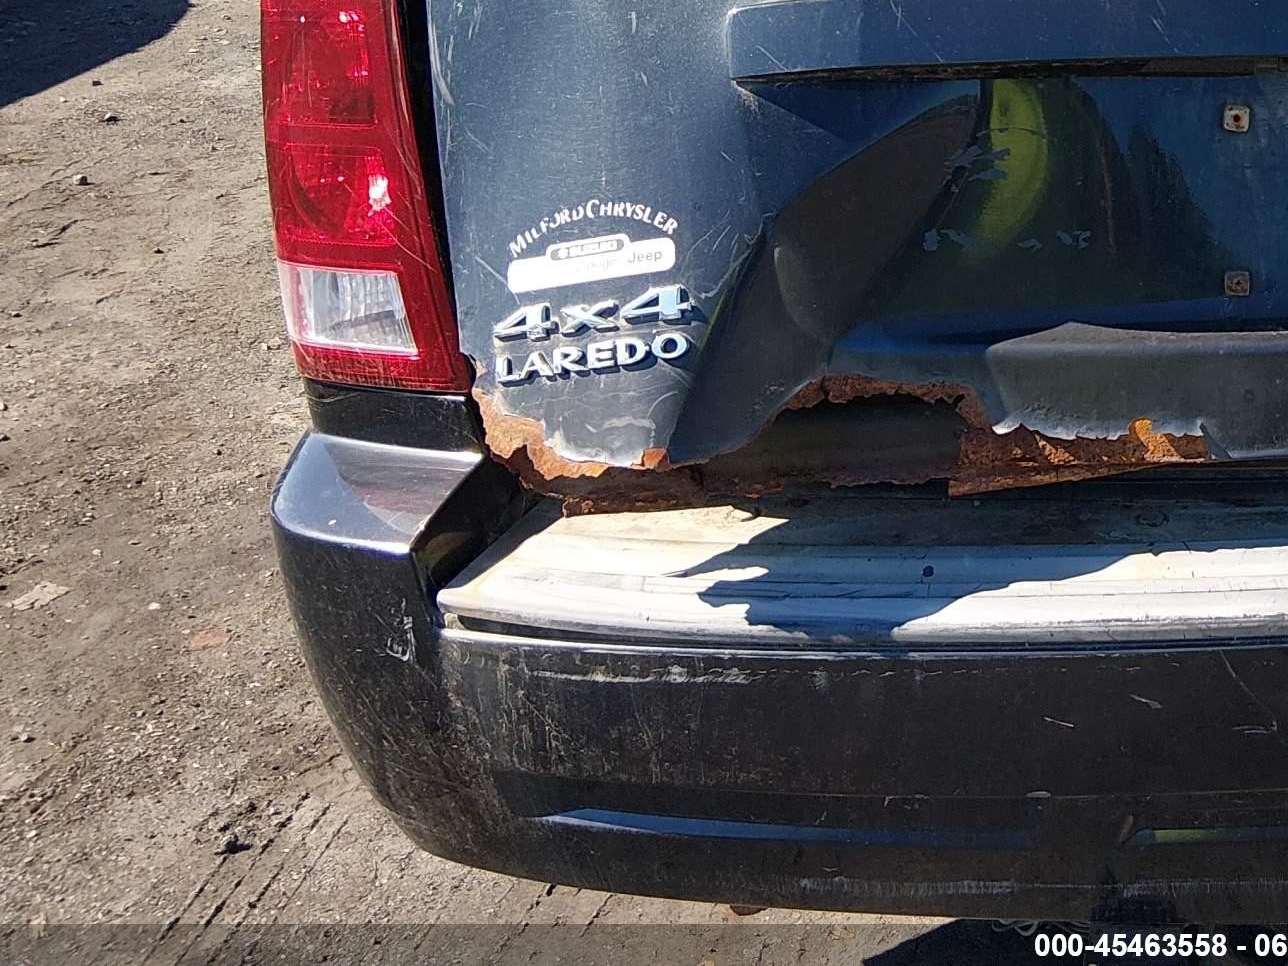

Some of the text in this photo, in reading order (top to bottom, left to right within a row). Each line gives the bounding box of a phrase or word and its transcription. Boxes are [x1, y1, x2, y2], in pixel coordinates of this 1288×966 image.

[585, 199, 680, 235] CHRYSLER
[627, 250, 663, 265] Jeep
[495, 332, 691, 388] LAREDO
